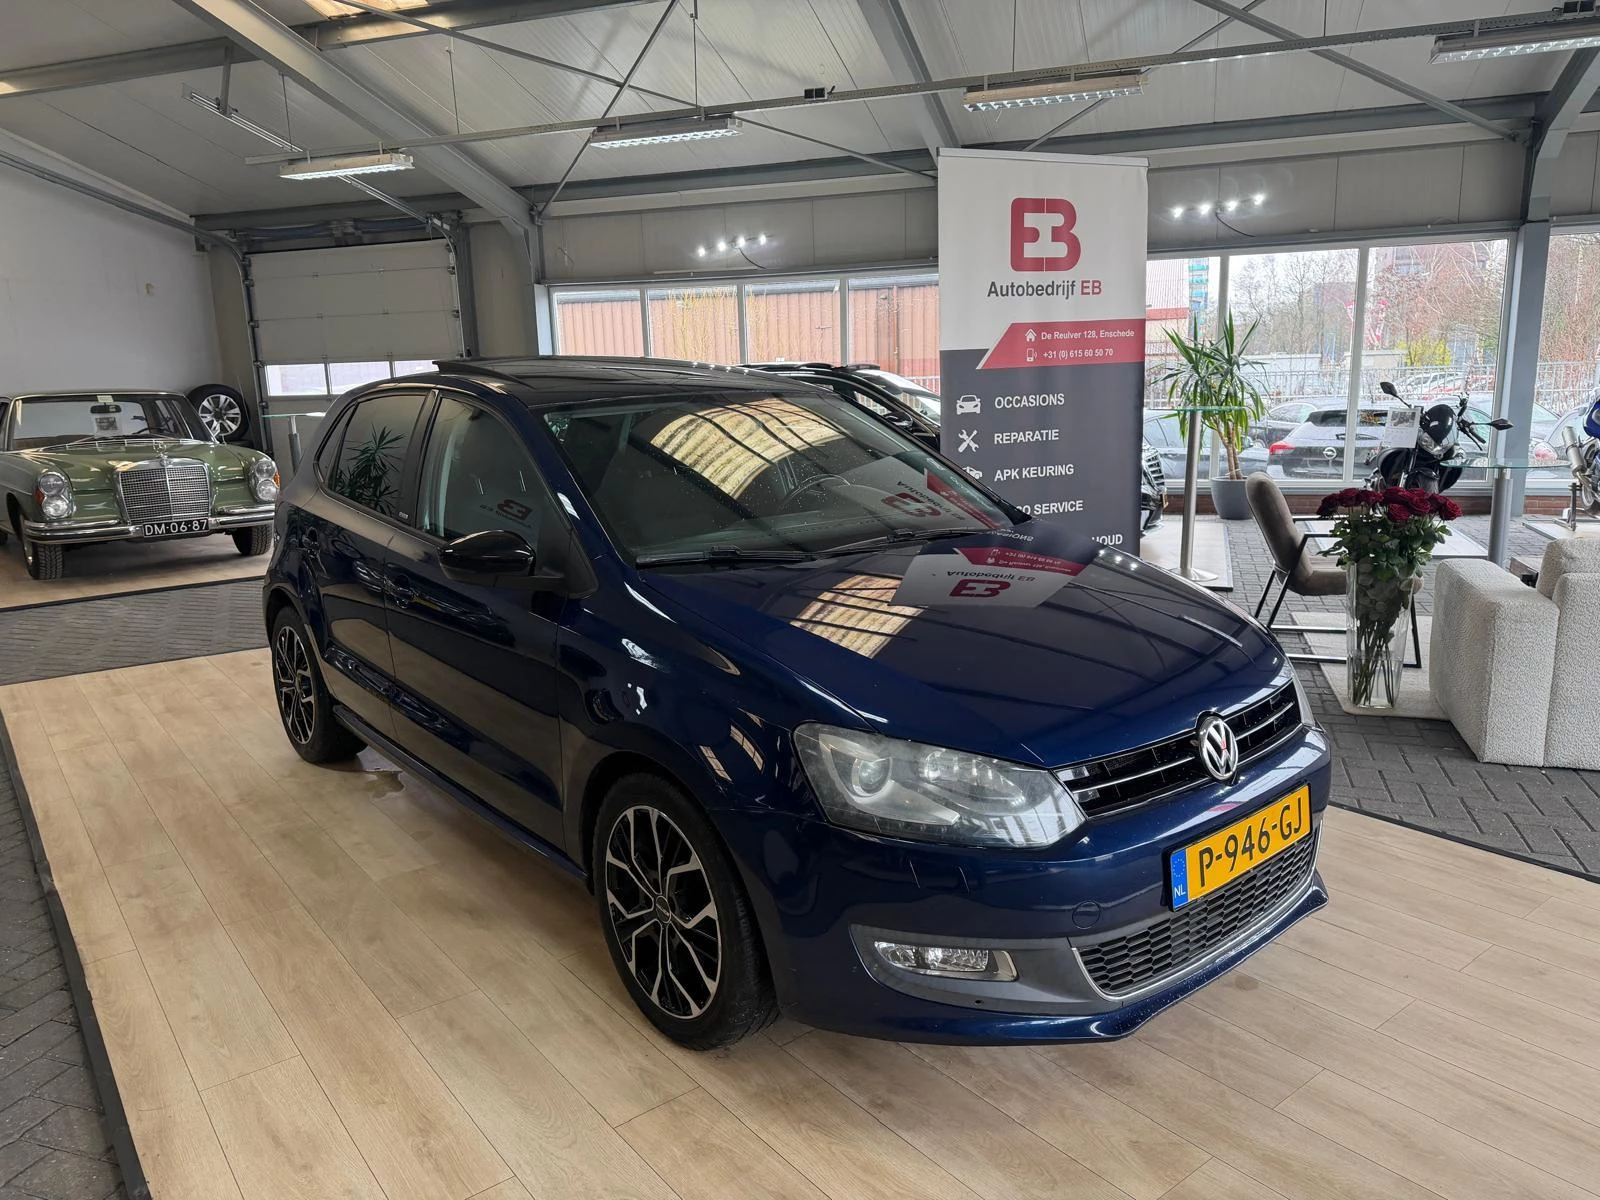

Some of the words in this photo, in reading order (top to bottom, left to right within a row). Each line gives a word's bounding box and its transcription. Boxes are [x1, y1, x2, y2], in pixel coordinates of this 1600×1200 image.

[1010, 197, 1082, 272] EB
[987, 280, 1076, 299] Autobedrijf
[1080, 280, 1102, 295] EB
[1041, 331, 1052, 340] De
[1053, 331, 1081, 340] Reulver
[1083, 330, 1098, 339] 128,
[1100, 329, 1135, 338] Enschede
[1043, 350, 1057, 359] +31
[1058, 350, 1068, 360] (0)
[1069, 349, 1083, 358] 615
[1084, 349, 1093, 357] 60
[1094, 348, 1104, 357] 50
[1105, 348, 1114, 356] 70
[994, 393, 1065, 409] OCCASIONS
[994, 429, 1060, 445] REPARATIE
[994, 467, 1020, 482] APK
[1022, 463, 1075, 479] KEURING
[1033, 500, 1084, 515] SERVICE
[1198, 797, 1303, 888] P-946-GJ
[1174, 885, 1186, 897] NL
